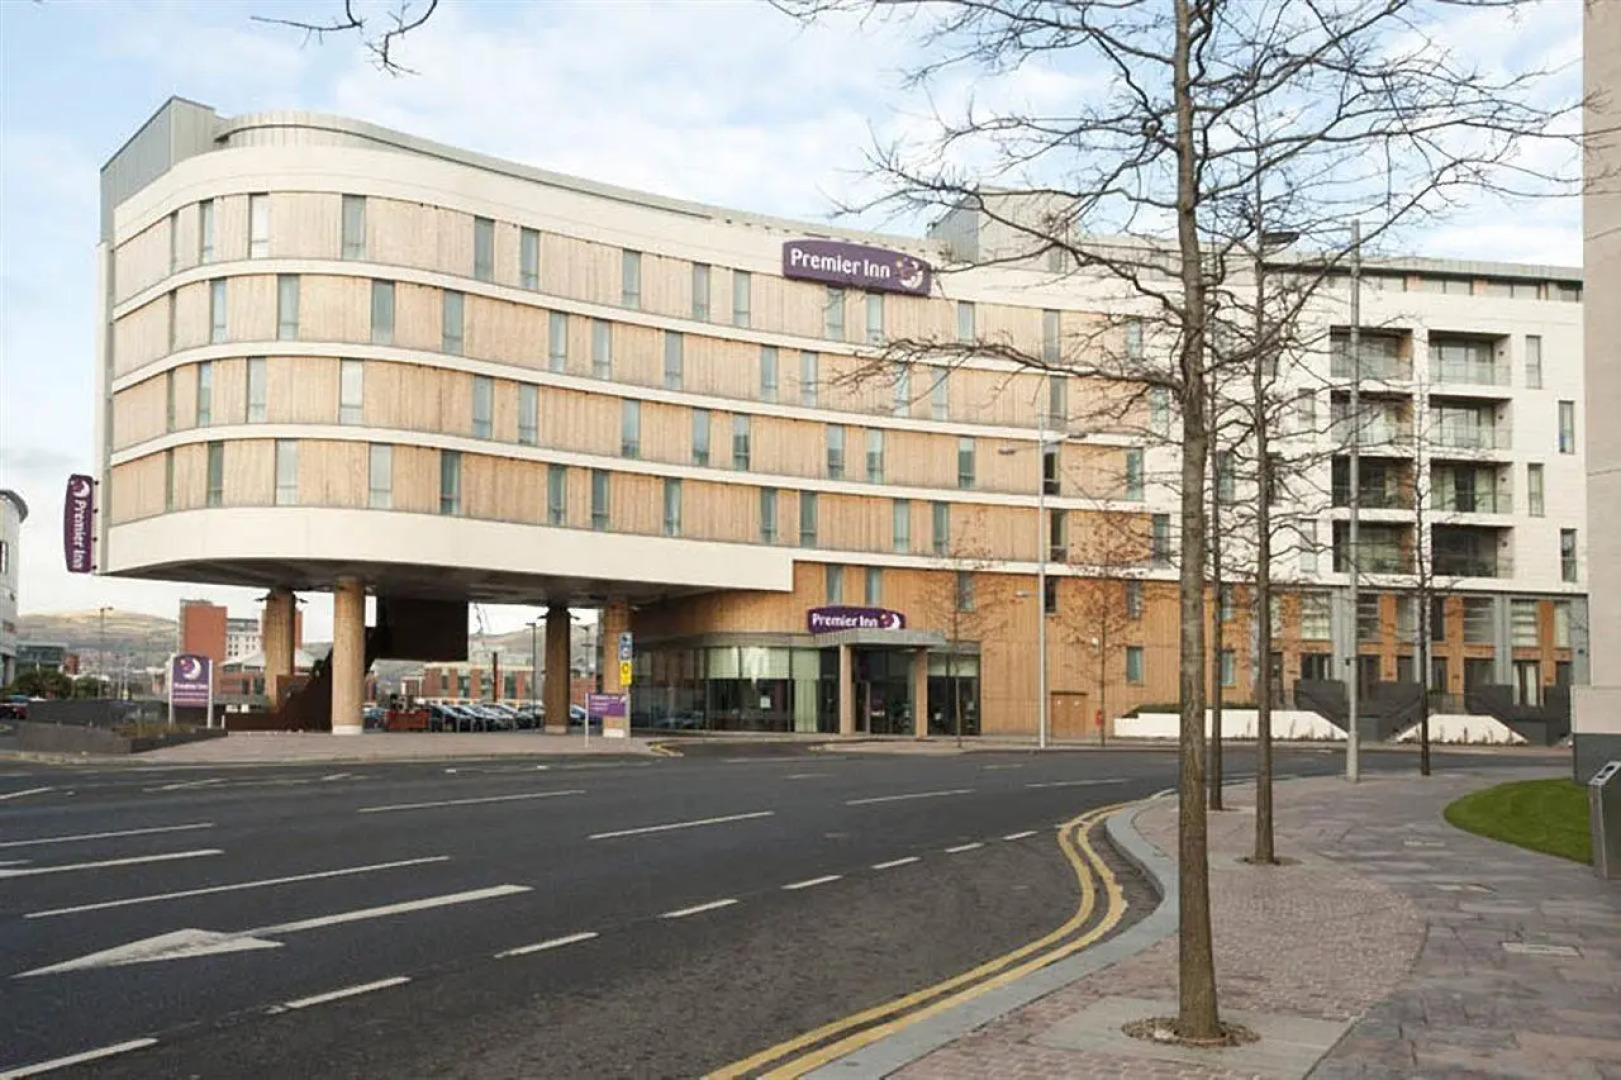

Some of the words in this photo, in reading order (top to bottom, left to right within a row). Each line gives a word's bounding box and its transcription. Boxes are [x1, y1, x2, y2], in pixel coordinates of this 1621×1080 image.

[790, 248, 861, 275] Premier
[864, 259, 890, 278] Inn
[812, 613, 858, 627] Premier
[859, 615, 878, 627] Inn
